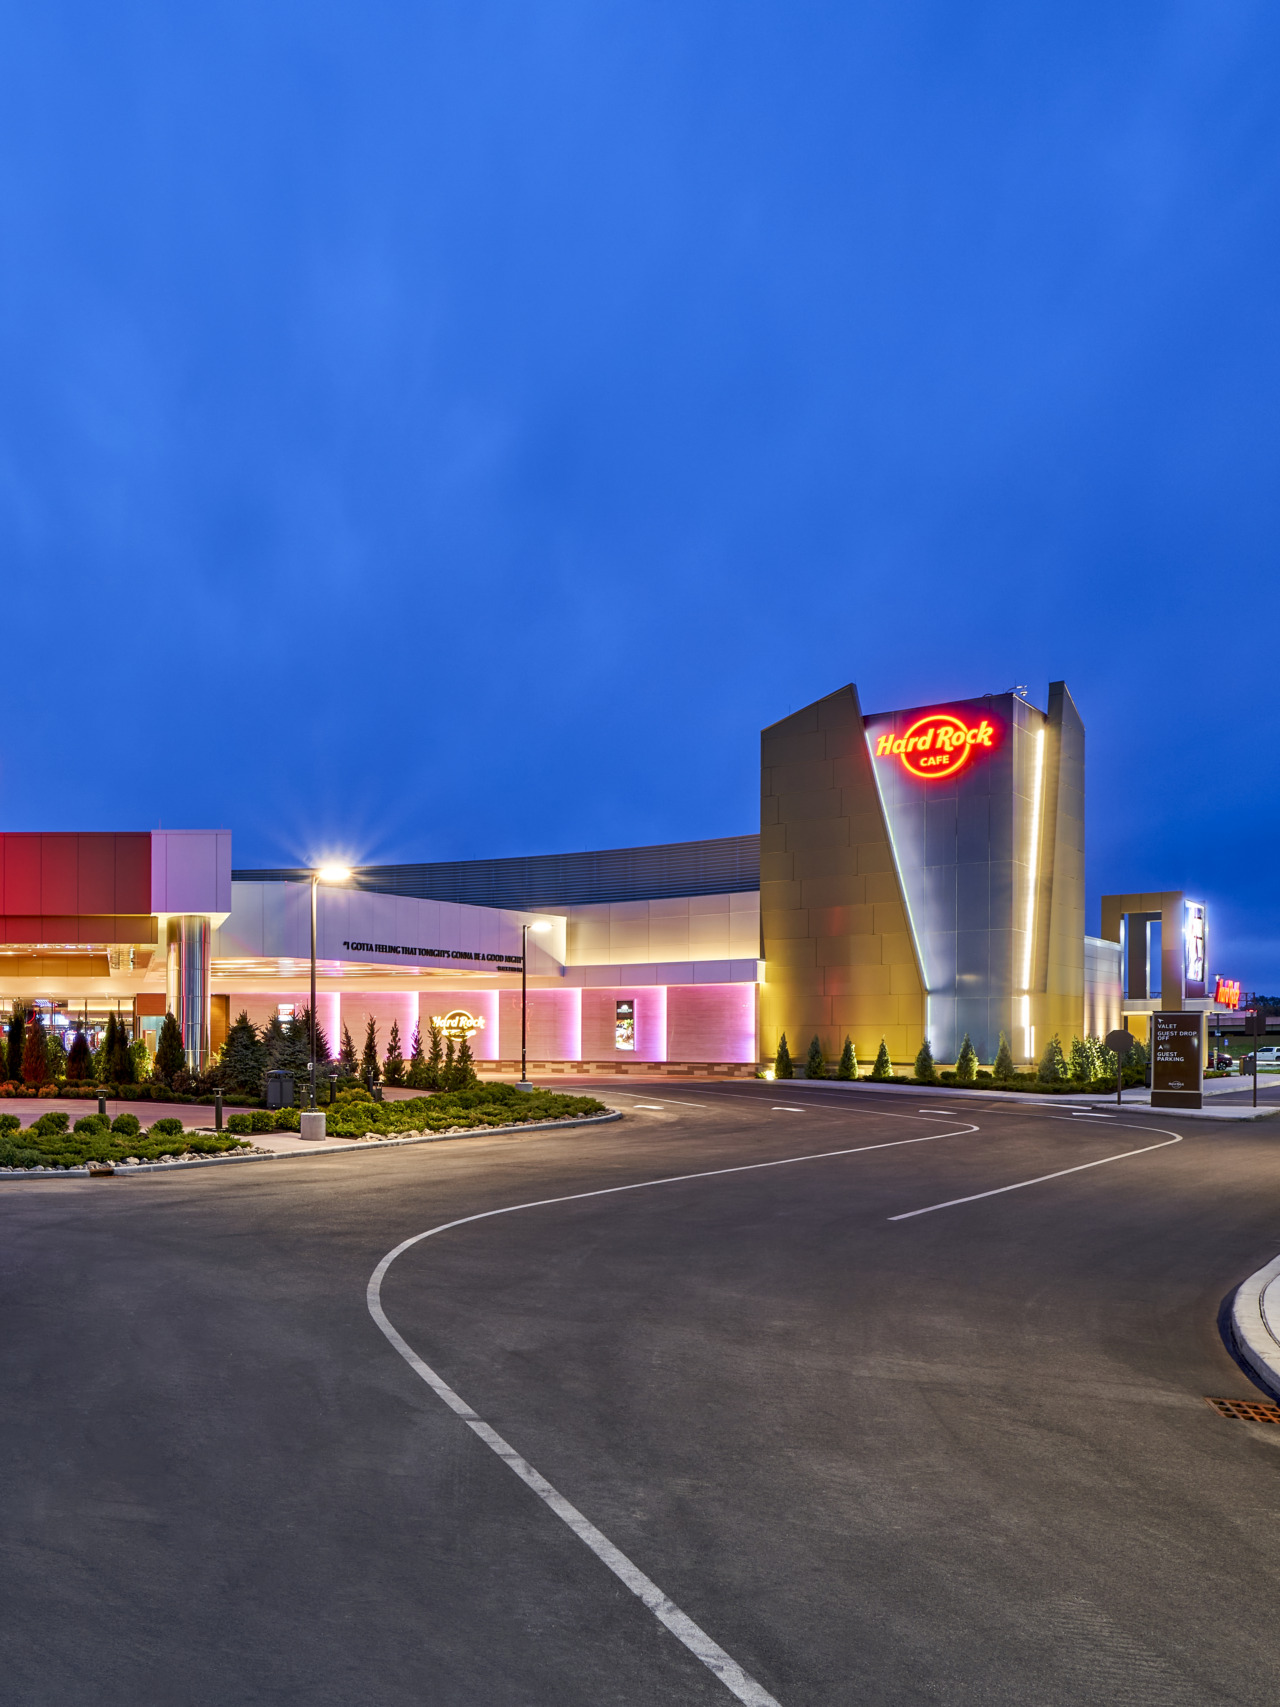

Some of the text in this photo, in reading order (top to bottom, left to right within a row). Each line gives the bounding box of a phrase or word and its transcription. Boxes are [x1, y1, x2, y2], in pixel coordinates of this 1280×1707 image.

[876, 721, 993, 756] Hard Rock
[920, 755, 950, 767] CAFE
[351, 942, 374, 952] GOTTA
[375, 944, 400, 954] FEELING
[400, 946, 417, 956] THAT
[451, 950, 473, 960] GONNA
[486, 953, 504, 962] GOOD
[432, 1015, 486, 1030] Hard Rock
